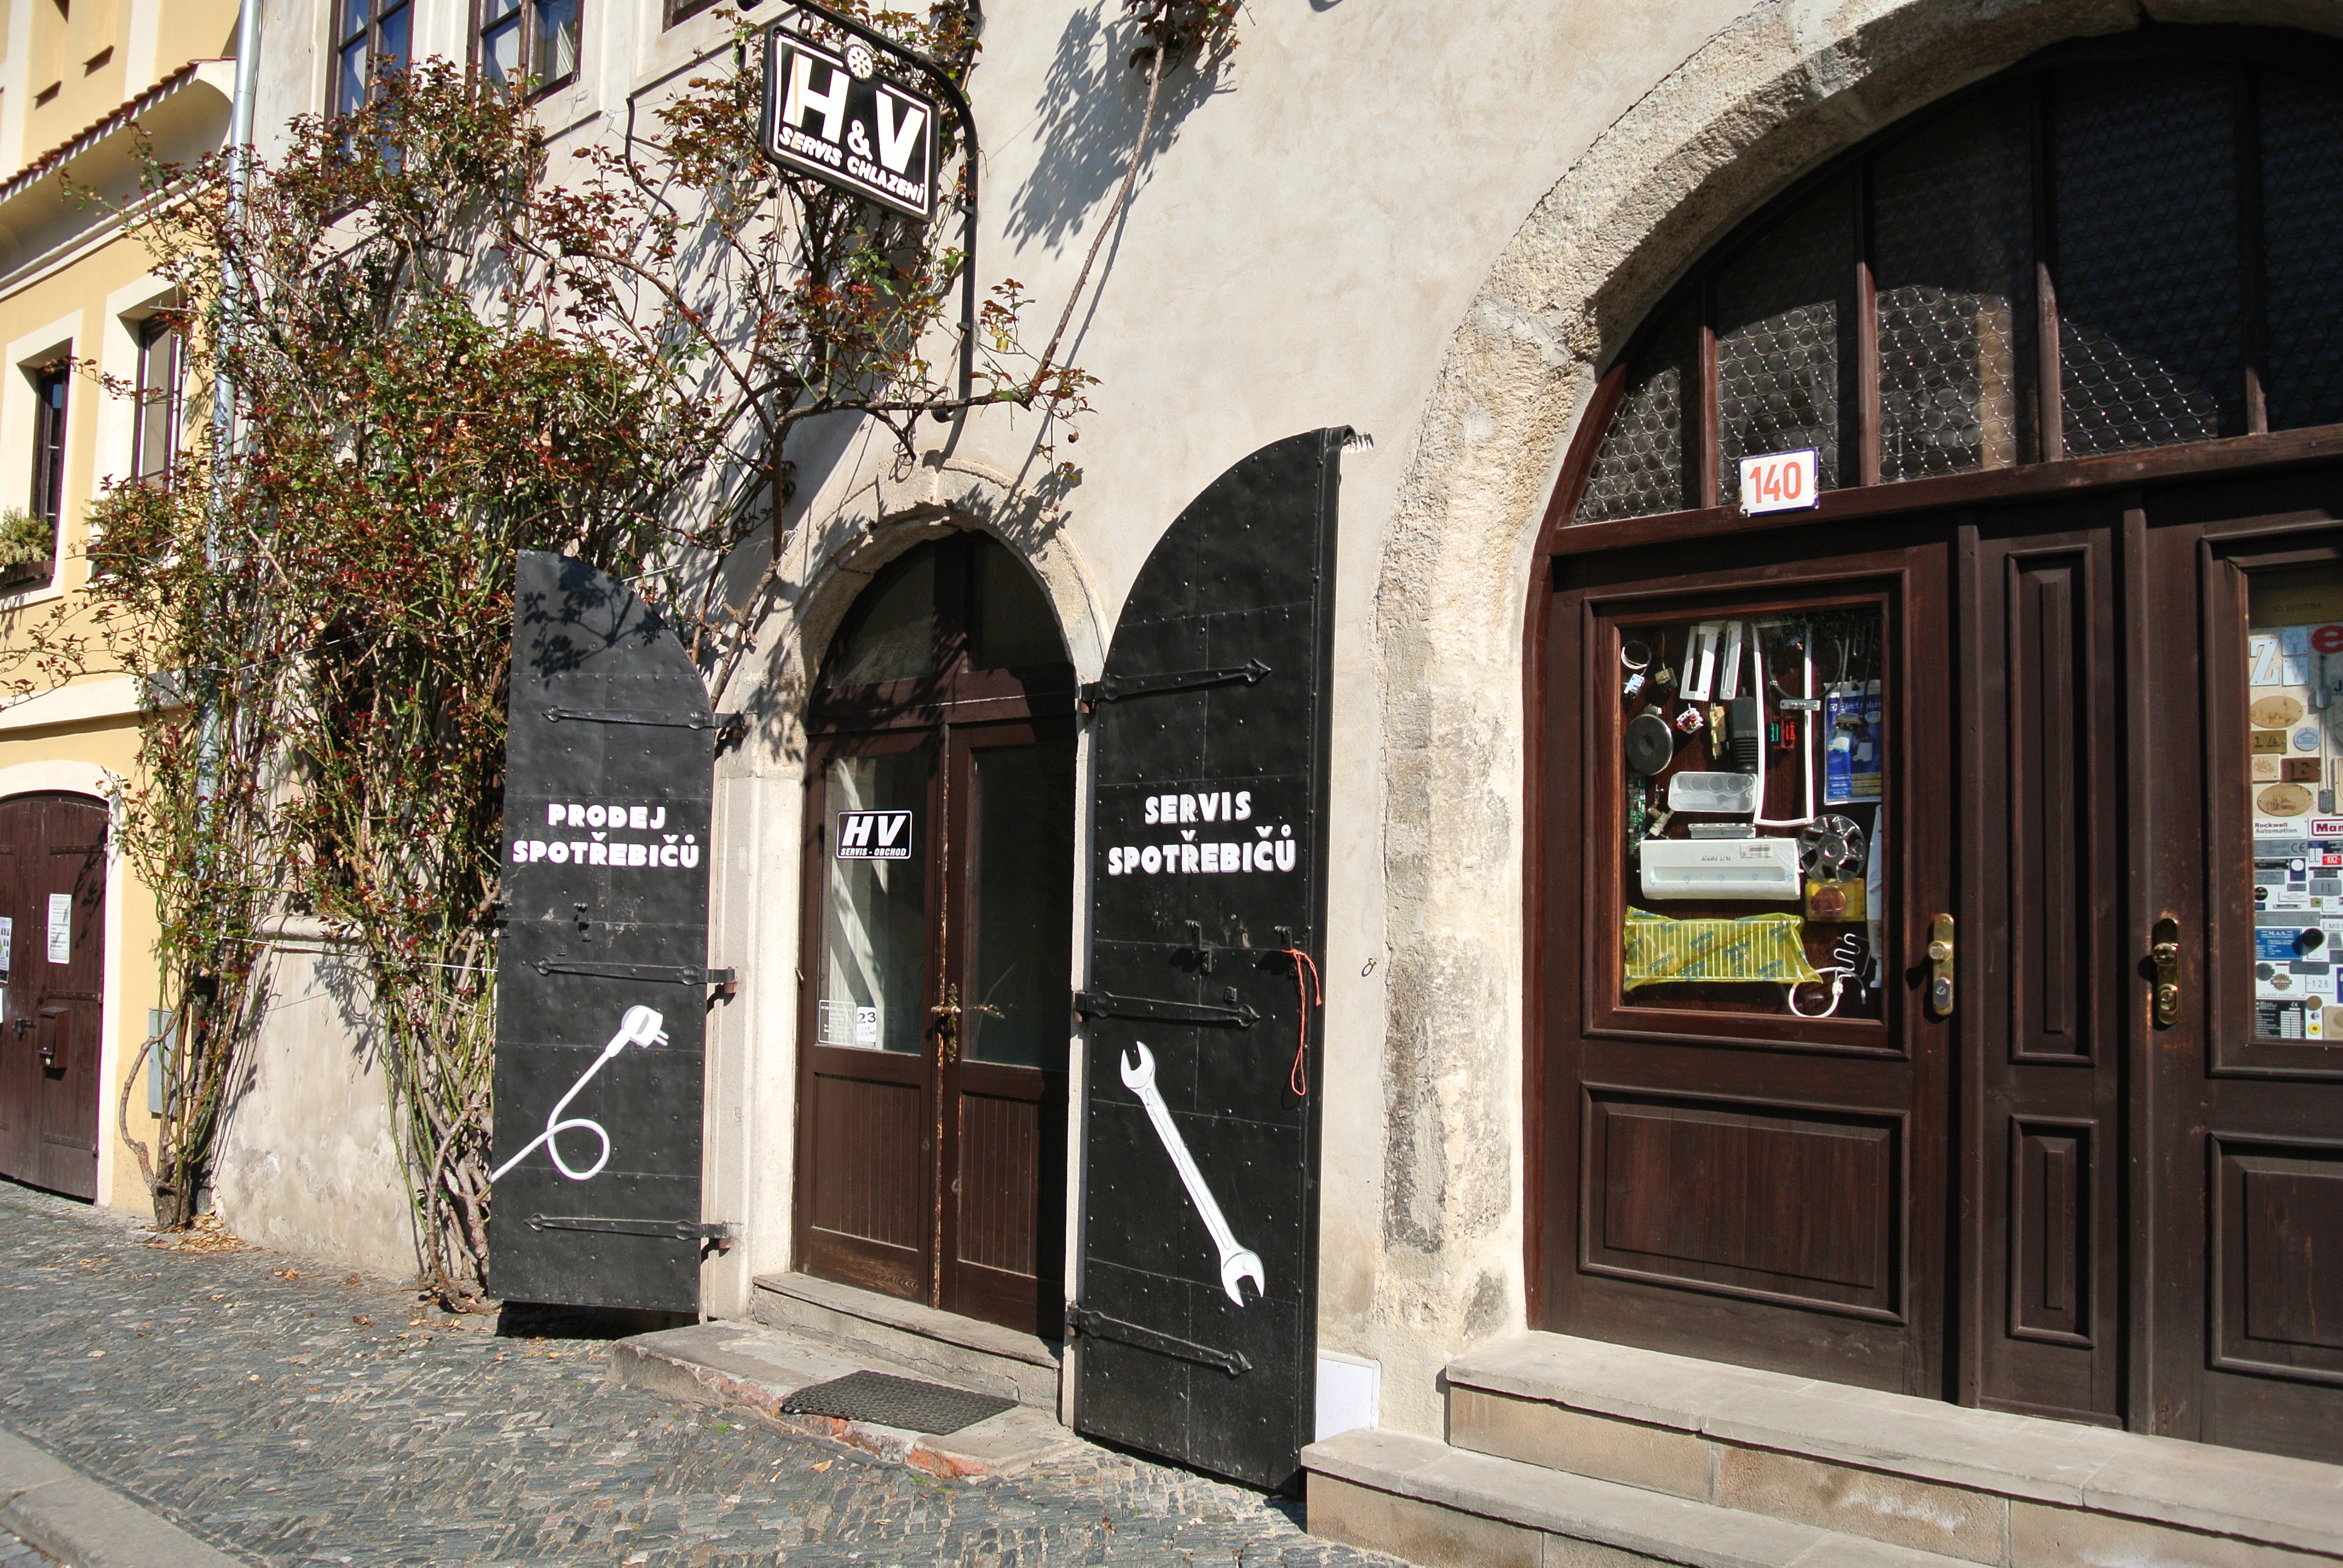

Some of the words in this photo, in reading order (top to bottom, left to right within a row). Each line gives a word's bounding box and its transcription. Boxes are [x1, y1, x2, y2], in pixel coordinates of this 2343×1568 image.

[779, 126, 842, 167] SERVIS
[1749, 461, 1801, 504] 140
[548, 803, 666, 829] PRODEJ
[1145, 791, 1251, 825] SERVIS
[513, 831, 700, 869] SPOTŘEBIČŮ
[841, 848, 868, 856] SERVIS
[874, 848, 907, 856] OBCHOD
[1108, 824, 1296, 876] SPOTŘEBIČŮ
[1690, 930, 1714, 949] gorenje
[1648, 953, 1671, 971] gorenje
[856, 1011, 876, 1024] 23
